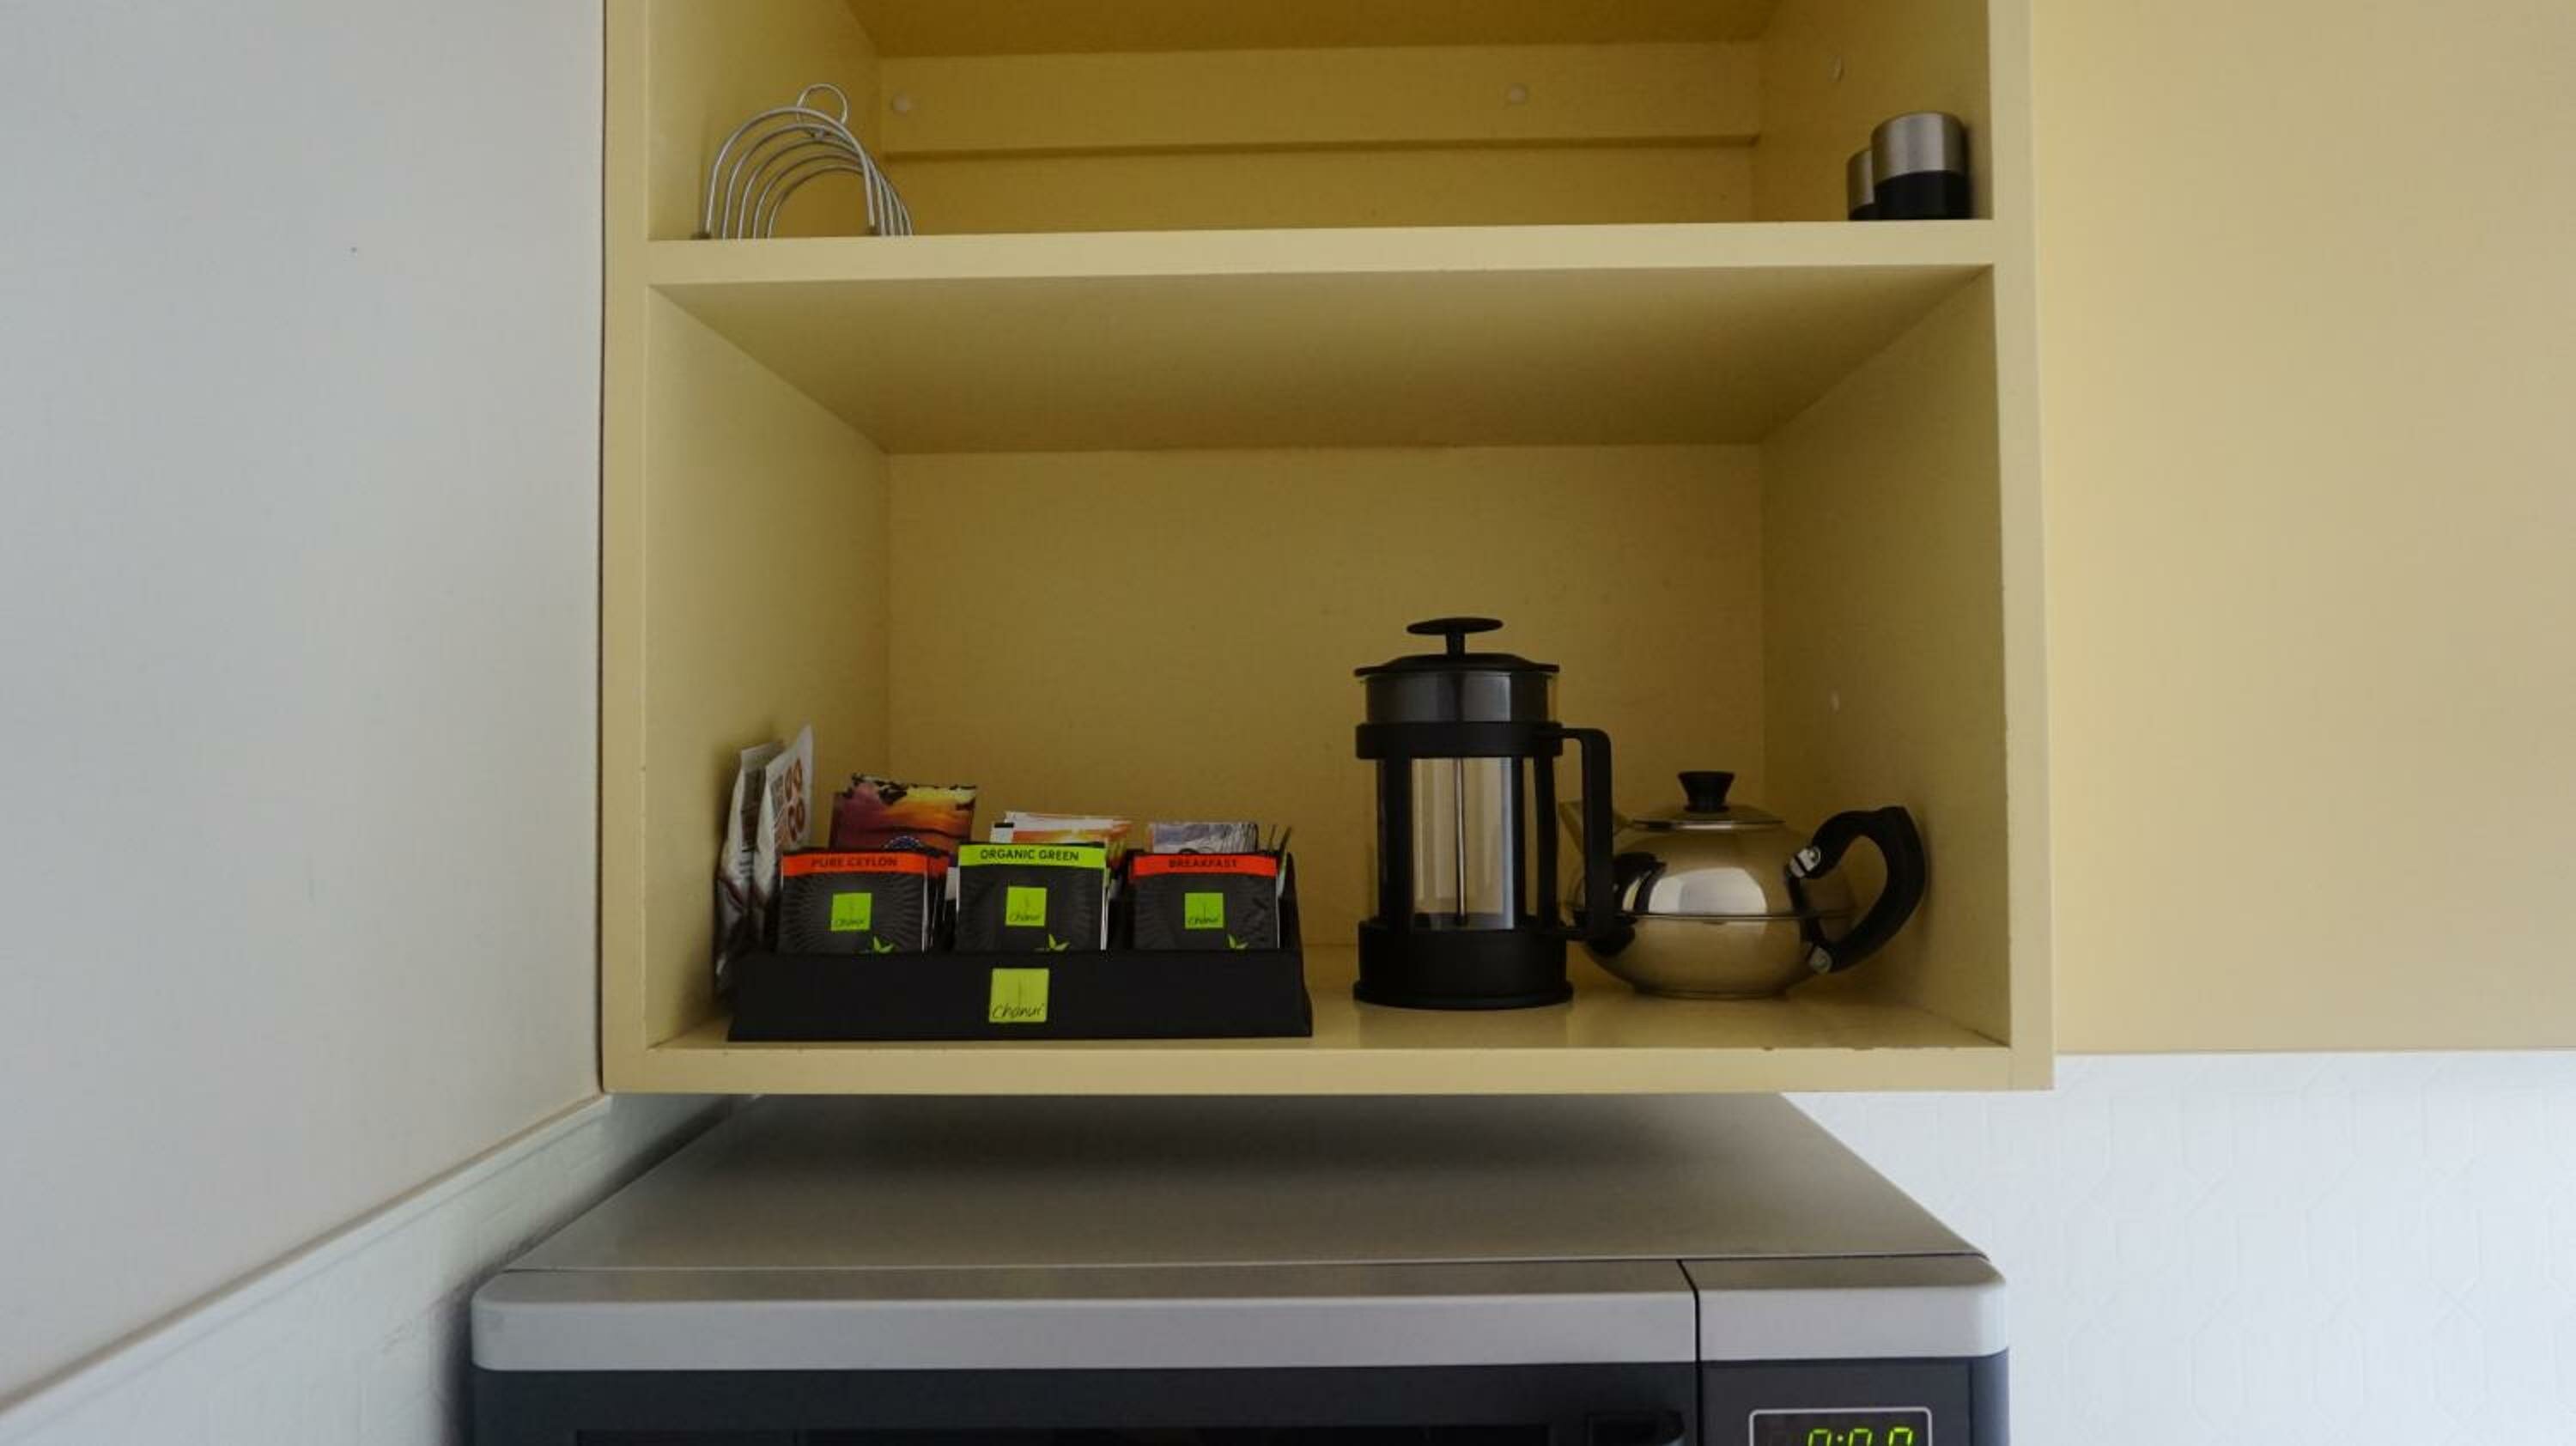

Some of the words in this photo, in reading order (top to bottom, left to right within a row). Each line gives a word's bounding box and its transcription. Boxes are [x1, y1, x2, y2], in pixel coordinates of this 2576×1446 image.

[980, 848, 1036, 860] ORGANIC
[1038, 849, 1079, 861] GREEN
[811, 857, 845, 867] PURE
[847, 855, 898, 866] CEYLON
[1169, 859, 1236, 868] BREAKFAST
